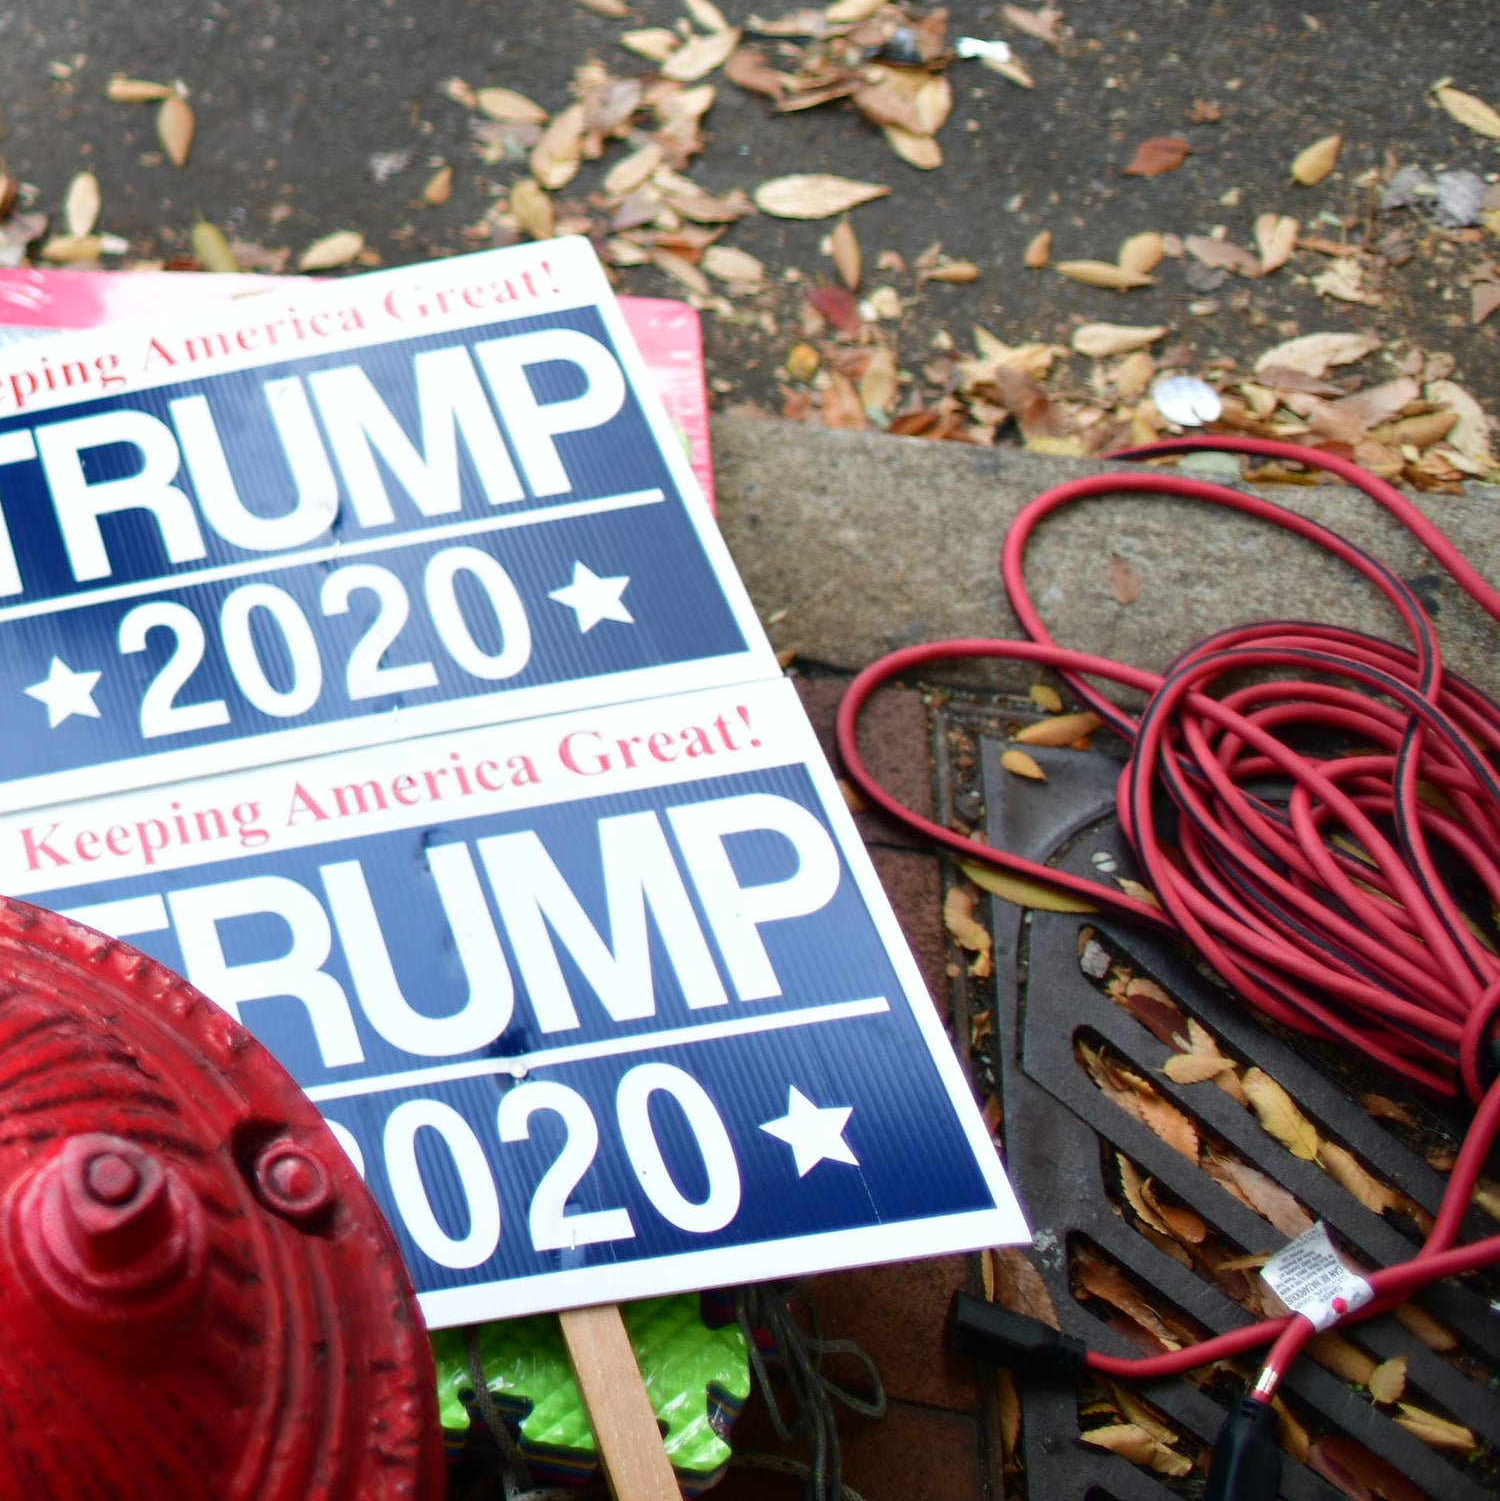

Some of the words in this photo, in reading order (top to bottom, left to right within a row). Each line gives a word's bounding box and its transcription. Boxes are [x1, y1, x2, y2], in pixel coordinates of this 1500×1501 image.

[142, 305, 367, 373] America
[382, 260, 561, 323] Great!
[117, 545, 533, 740] 2020
[18, 801, 271, 872] Keeping
[285, 752, 542, 829] America
[557, 704, 763, 776] Great!
[322, 1061, 743, 1271] 020
